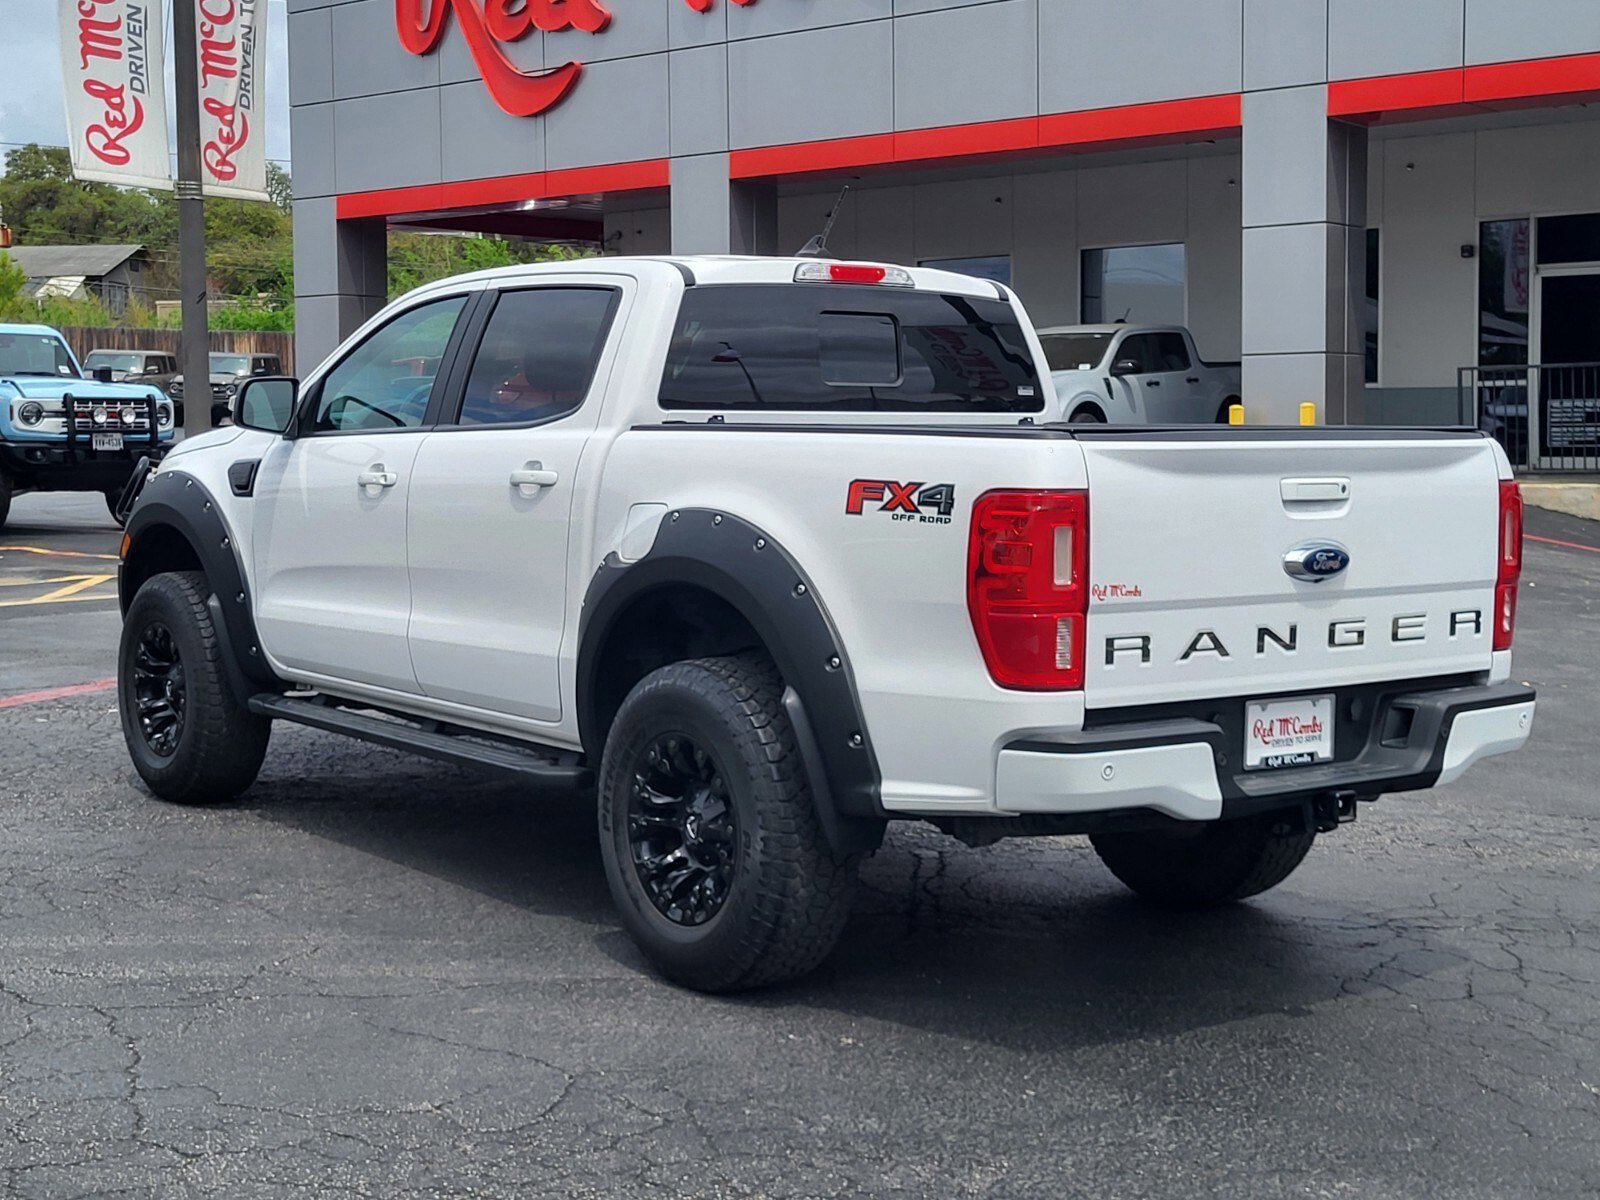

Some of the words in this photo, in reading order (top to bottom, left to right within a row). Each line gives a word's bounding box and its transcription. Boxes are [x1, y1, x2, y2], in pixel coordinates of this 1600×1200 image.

[78, 0, 123, 70] Mc
[126, 4, 145, 94] DRIVEN
[240, 24, 253, 110] DRIVEN
[83, 79, 144, 166] Red
[203, 97, 249, 181] Red
[845, 478, 955, 516] FX4
[891, 513, 915, 521] OFF
[919, 515, 952, 524] ROAD
[1312, 551, 1342, 570] Ford
[1091, 584, 1107, 601] Red
[1104, 609, 1482, 666] RANGER
[1253, 718, 1274, 745] Red
[1275, 715, 1323, 736] McCombs
